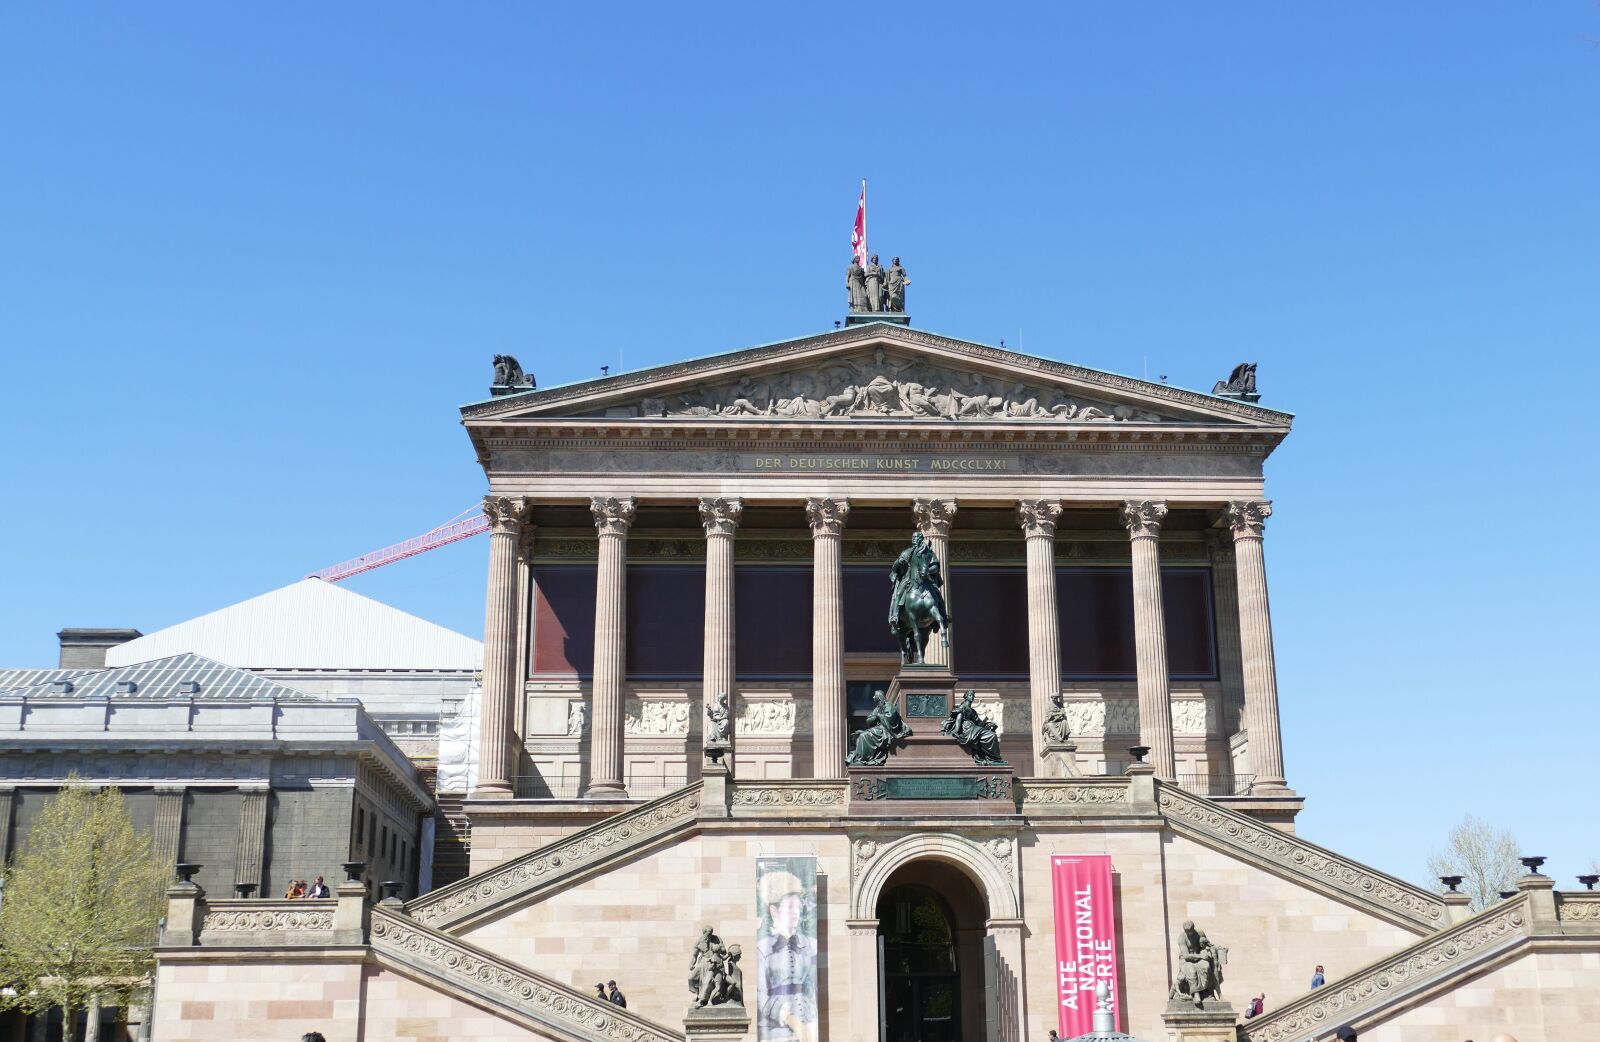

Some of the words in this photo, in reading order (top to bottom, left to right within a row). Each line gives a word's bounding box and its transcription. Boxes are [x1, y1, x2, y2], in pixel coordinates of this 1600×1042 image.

[756, 458, 782, 468] DER
[789, 458, 869, 469] DEUTSCHEN
[876, 459, 920, 469] KUNST
[931, 459, 1007, 470] MDCCCLXXI
[1074, 884, 1096, 991] NATIONAL
[1060, 960, 1078, 1010] ALTE
